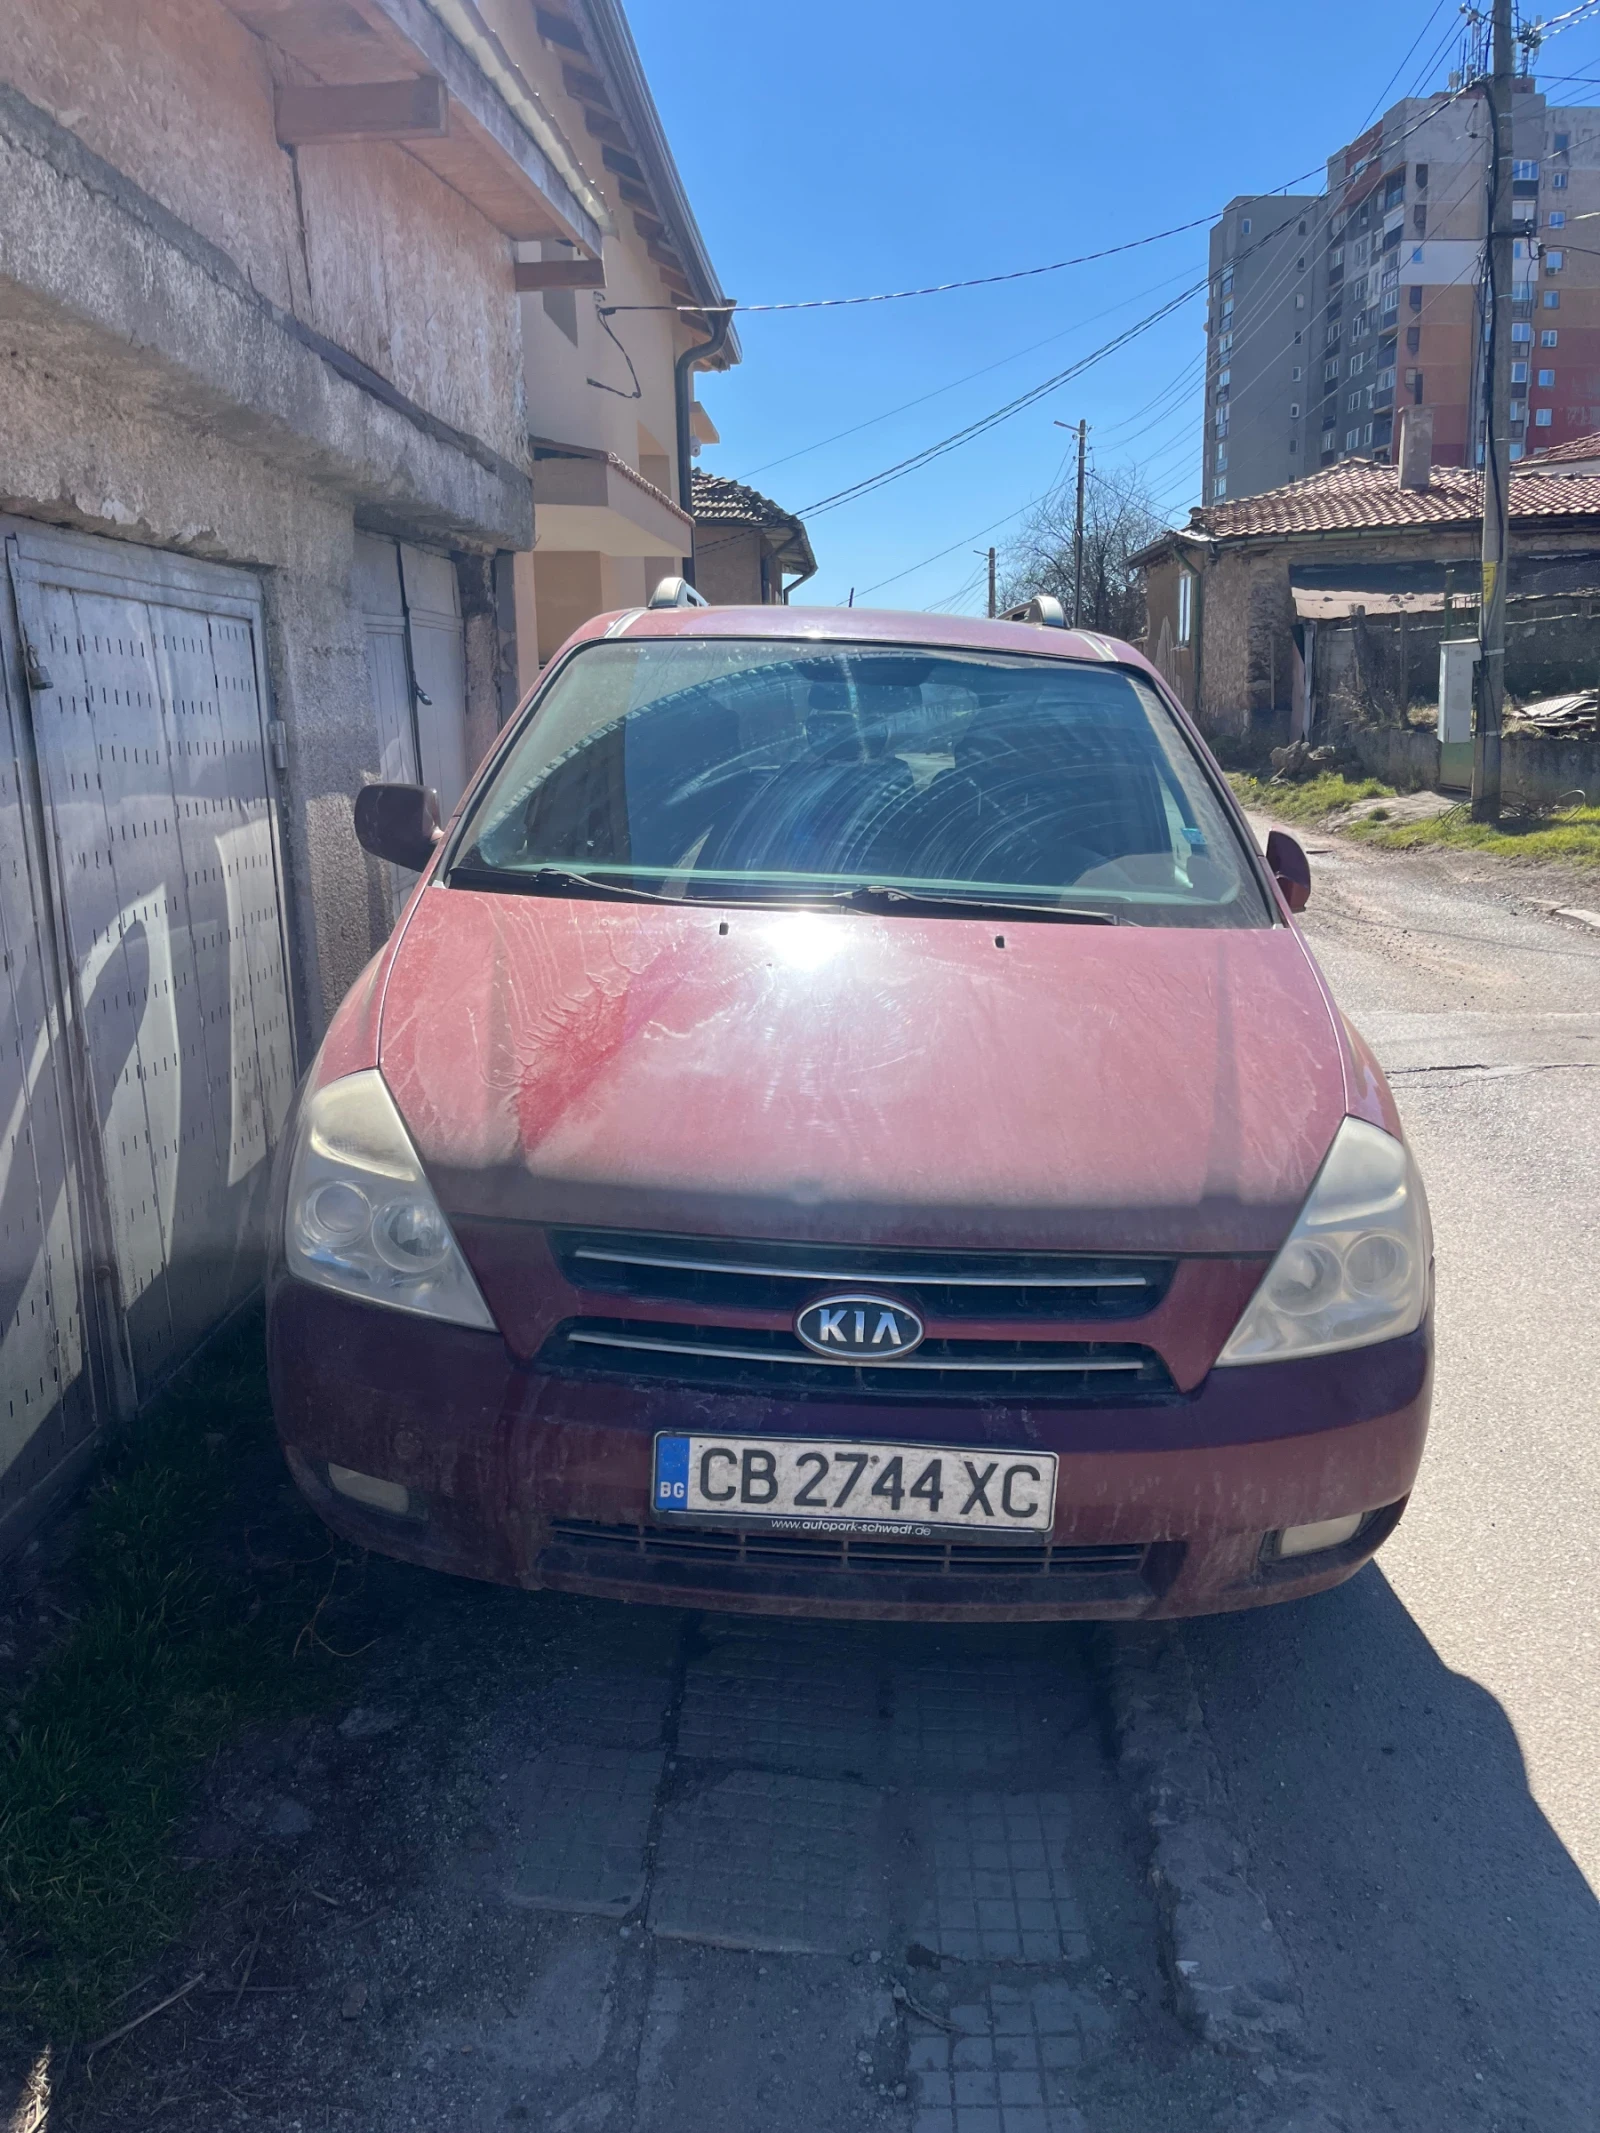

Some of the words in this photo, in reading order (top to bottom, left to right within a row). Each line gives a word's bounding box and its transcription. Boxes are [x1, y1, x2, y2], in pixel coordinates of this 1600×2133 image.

[818, 1308, 902, 1345] KIA
[659, 1481, 685, 1498] BG
[700, 1447, 779, 1504] CB
[793, 1452, 944, 1512] 2744
[959, 1461, 1041, 1518] XC
[771, 1519, 931, 1536] www.autopark-schwedt.de
